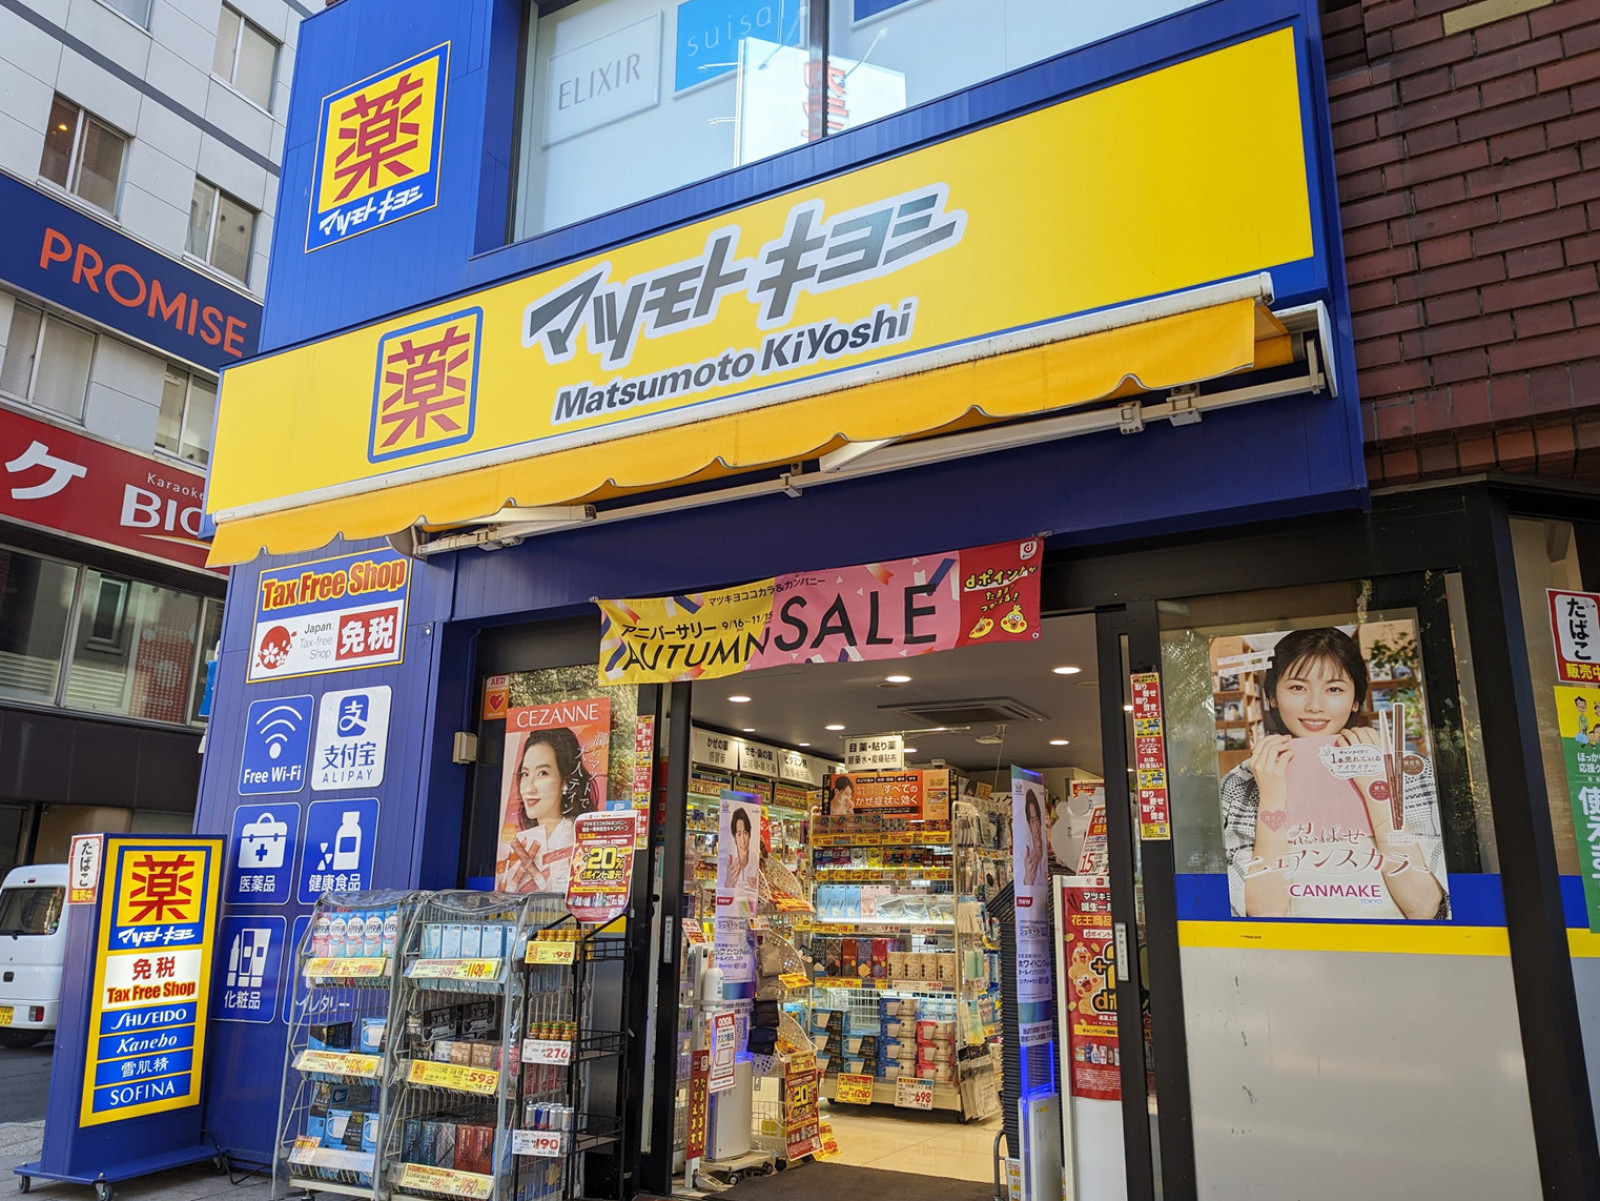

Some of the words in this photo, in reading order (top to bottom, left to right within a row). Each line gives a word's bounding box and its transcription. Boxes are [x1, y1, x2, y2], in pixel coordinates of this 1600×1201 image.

[687, 5, 784, 57] suisa
[558, 52, 641, 111] ELIXIR
[331, 73, 424, 203] 薬
[319, 185, 424, 236] マツモトキヨシ
[529, 193, 957, 361] マツモトキヨシ
[39, 227, 249, 359] PROMISE
[555, 350, 754, 422] Matsumoto
[761, 302, 914, 371] KiYoshi
[380, 325, 472, 448] 薬
[5, 440, 88, 500] ケ
[147, 472, 205, 501] Karaoke
[262, 579, 299, 610] Tax
[299, 570, 347, 604] Free
[348, 559, 407, 595] Shop
[774, 583, 937, 651] SALE
[339, 614, 395, 656] 免税
[621, 622, 717, 641] アニバーサリー
[1567, 598, 1592, 661] たばこ
[300, 636, 333, 648] Tax-free
[621, 626, 771, 671] AUTUMN
[310, 649, 331, 660] Shop
[490, 676, 506, 686] AED
[1566, 663, 1600, 680] 販売中
[516, 703, 599, 728] CEZANNE
[322, 741, 377, 771] 支付宝
[243, 768, 268, 784] Free
[271, 765, 302, 782] Wi-Fi
[322, 769, 373, 784] ALIPAY
[1288, 822, 1366, 845] 忍ばせ
[79, 840, 93, 887] たばこ
[587, 846, 624, 870] 20%
[1244, 848, 1430, 878] ニュアンスカラー
[129, 854, 195, 922] 薬
[239, 874, 275, 893] 医薬品
[308, 874, 361, 893] 健康食品
[1289, 884, 1382, 898] CANMAKE
[1071, 914, 1112, 926] 花王商品
[118, 927, 195, 947] マツモトキヨシ
[132, 956, 175, 982] 免税
[107, 986, 131, 1003] Tax
[132, 983, 162, 1001] Free
[163, 980, 196, 999] Shop
[224, 991, 261, 1010] 化粧品
[294, 994, 351, 1013] イレタリー
[110, 1008, 187, 1030] SHISEIDO
[117, 1033, 178, 1054] Kanebo
[545, 1048, 568, 1059] 276
[121, 1057, 169, 1079] 雪肌精
[469, 1072, 495, 1085] 598
[110, 1081, 175, 1106] SOFINA
[915, 1092, 931, 1103] 698
[536, 1138, 559, 1150] 190
